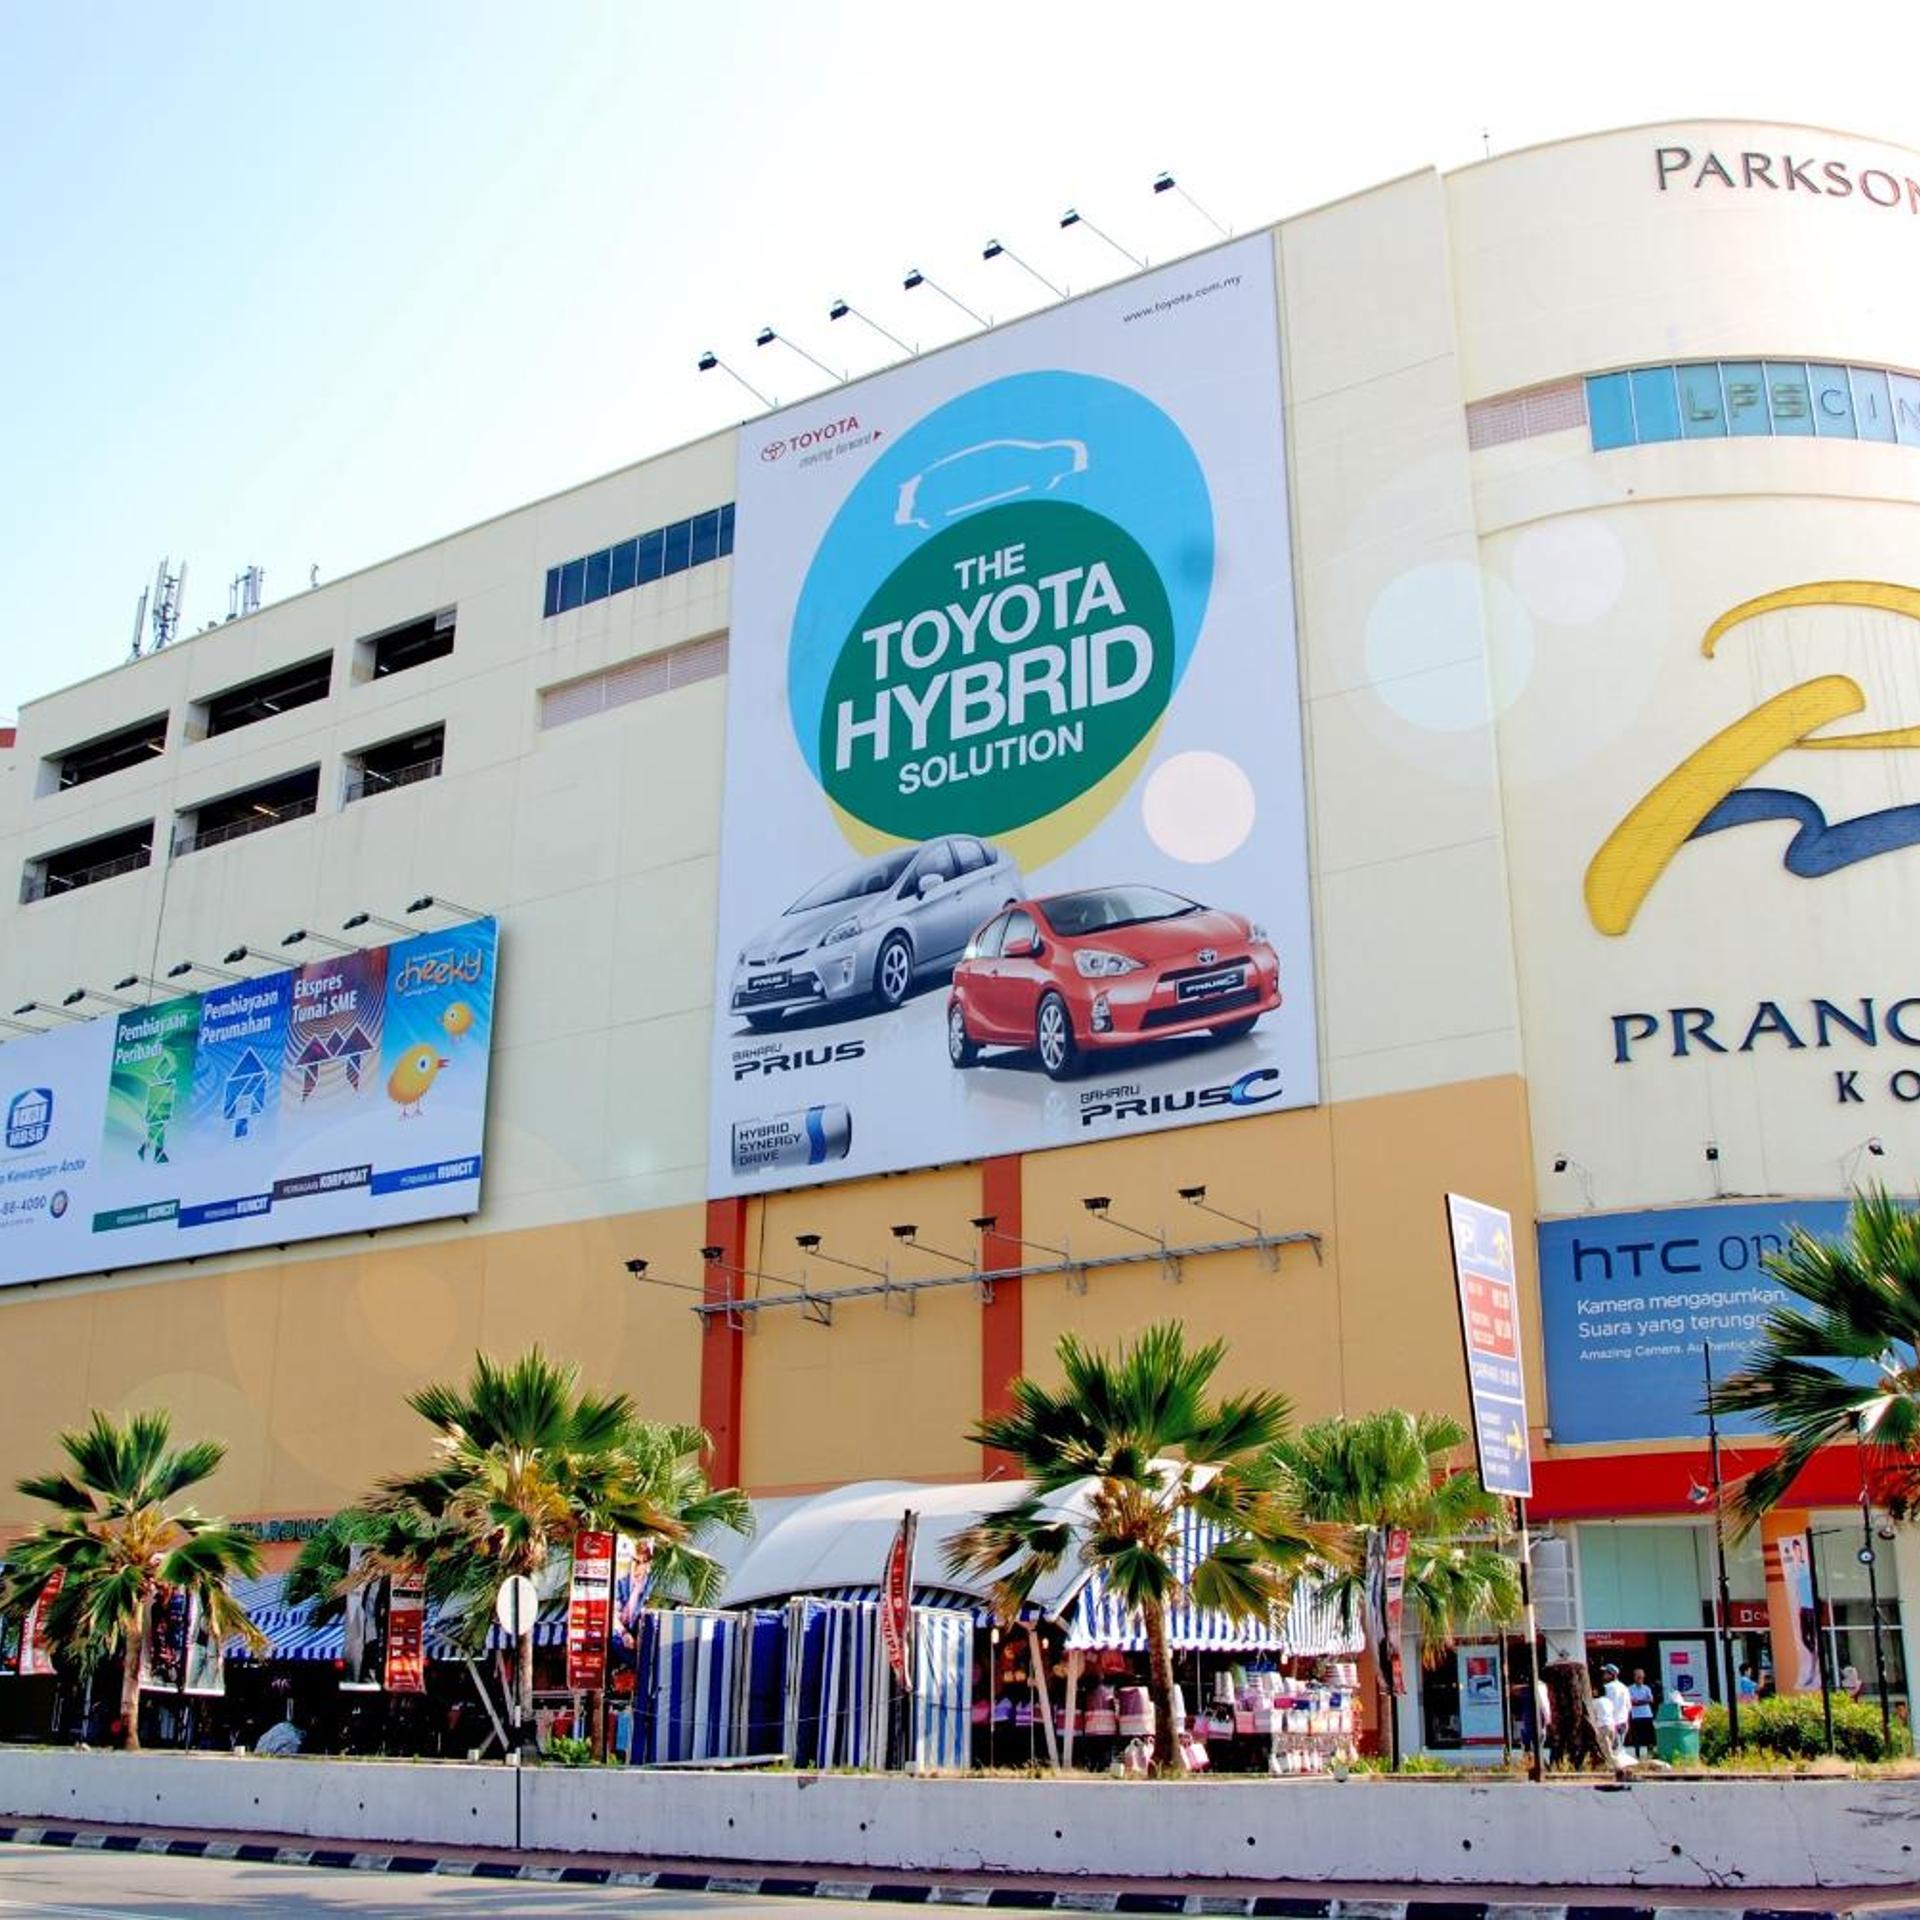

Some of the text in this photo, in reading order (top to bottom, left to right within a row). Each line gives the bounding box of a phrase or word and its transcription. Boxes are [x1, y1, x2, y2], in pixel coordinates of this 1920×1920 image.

[789, 416, 859, 452] TOYOTA
[954, 543, 1027, 591] THE
[862, 561, 1127, 681] TOYOTA
[834, 625, 1154, 772] HYBRID
[898, 723, 1085, 795] SOLUTION
[294, 974, 343, 1000] Ekspres
[204, 990, 280, 1022] Pembiayaan
[292, 990, 359, 1024] Tunai SME
[118, 1013, 188, 1044] Pembiayaan
[201, 1016, 271, 1045] Perumahan
[115, 1040, 164, 1066] Peribadi
[734, 1039, 866, 1081] PRIUS
[1080, 1083, 1141, 1105] BAHARU
[740, 1122, 790, 1141] HYBRID
[740, 1133, 803, 1154] SYNERGY
[740, 1149, 780, 1167] DRIVE
[1577, 1287, 1790, 1316] Kamera mengagumkan.
[1578, 1312, 1770, 1339] Suara yang terungg
[1579, 1346, 1632, 1362] Amazing
[1634, 1342, 1685, 1358] Camera.
[1686, 1338, 1751, 1354] Auhentic
